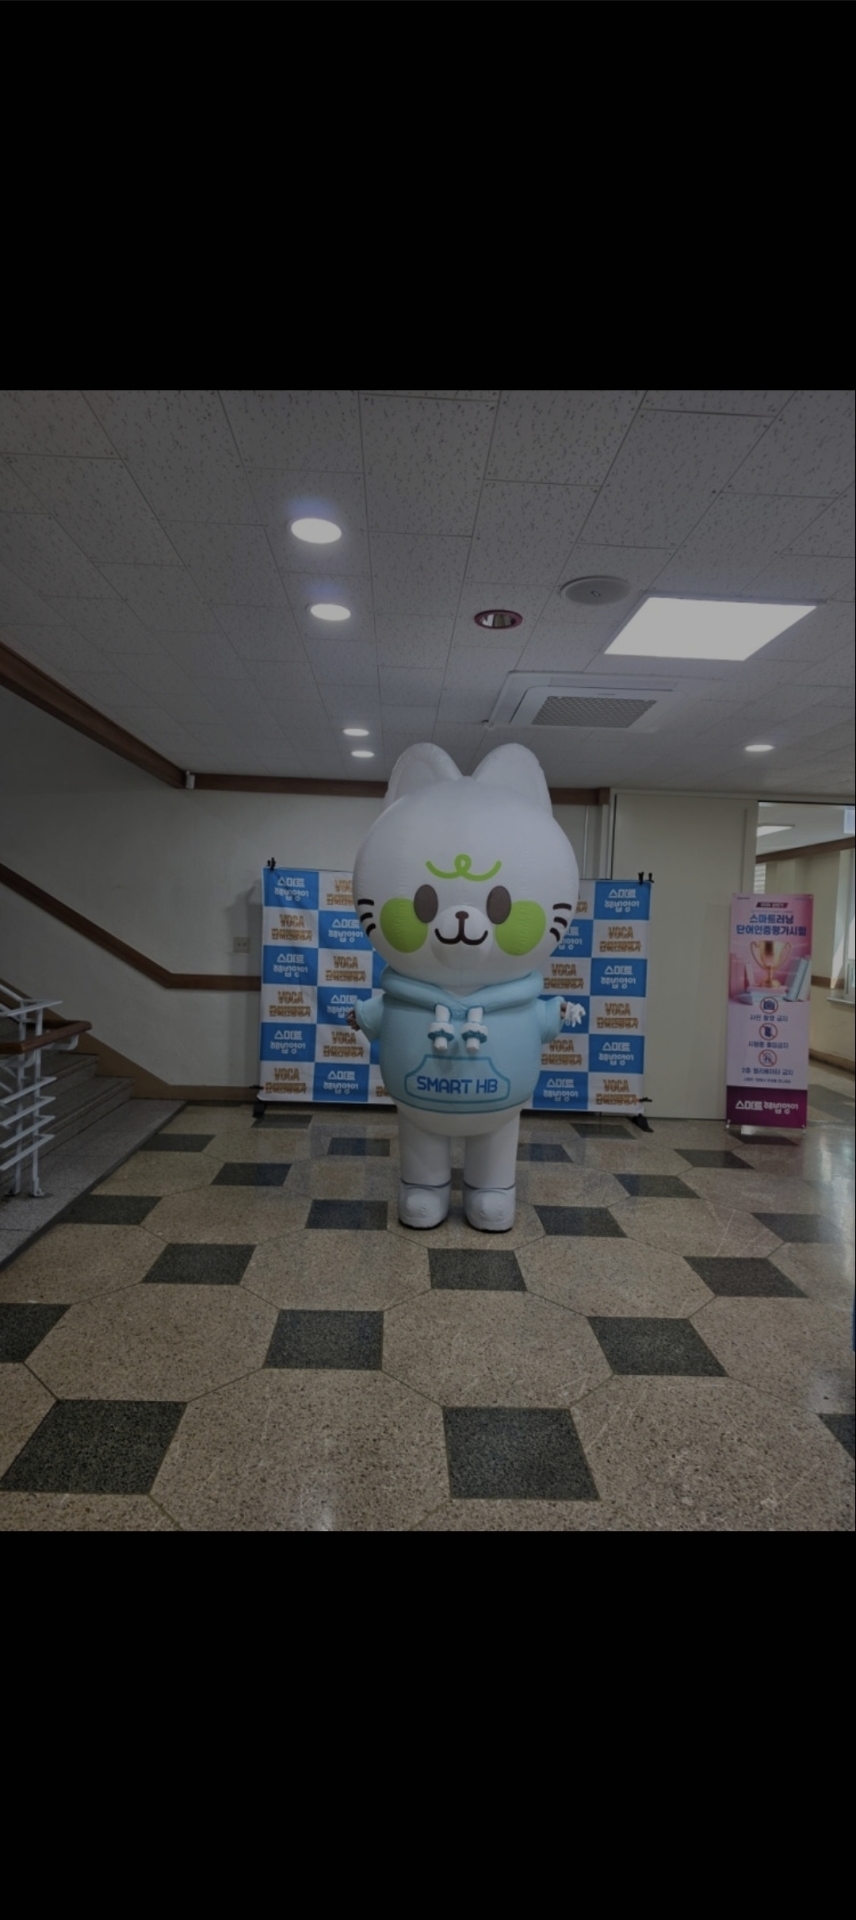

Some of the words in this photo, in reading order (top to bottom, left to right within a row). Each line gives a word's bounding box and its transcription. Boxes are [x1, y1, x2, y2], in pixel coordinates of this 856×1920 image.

[277, 877, 305, 888] 스마트
[335, 880, 353, 892] VOC
[608, 889, 636, 898] 스마트
[279, 914, 305, 927] VOCA
[332, 919, 360, 929] 스마트
[749, 914, 794, 925] 스마트러닝
[608, 926, 634, 939] VOCA
[736, 925, 807, 936] 단어인증평가시험
[276, 953, 305, 964] 스마트
[333, 956, 358, 969] VOCA
[551, 963, 577, 976] VOCA
[604, 965, 633, 975] 스마트
[278, 991, 304, 1004] VOCA
[604, 1003, 631, 1016] VOCA
[274, 1030, 302, 1040] 스마트
[331, 1031, 357, 1044] VOCA
[602, 1042, 630, 1052] 스마트
[274, 1067, 300, 1081] VOCA
[327, 1070, 356, 1081] 스마트
[416, 1076, 472, 1094] SMART
[476, 1079, 498, 1093] HB
[546, 1078, 575, 1088] 스마트
[603, 1079, 630, 1092] VOCA
[735, 1100, 763, 1111] 스마트
[764, 1101, 799, 1114] 해법영어
